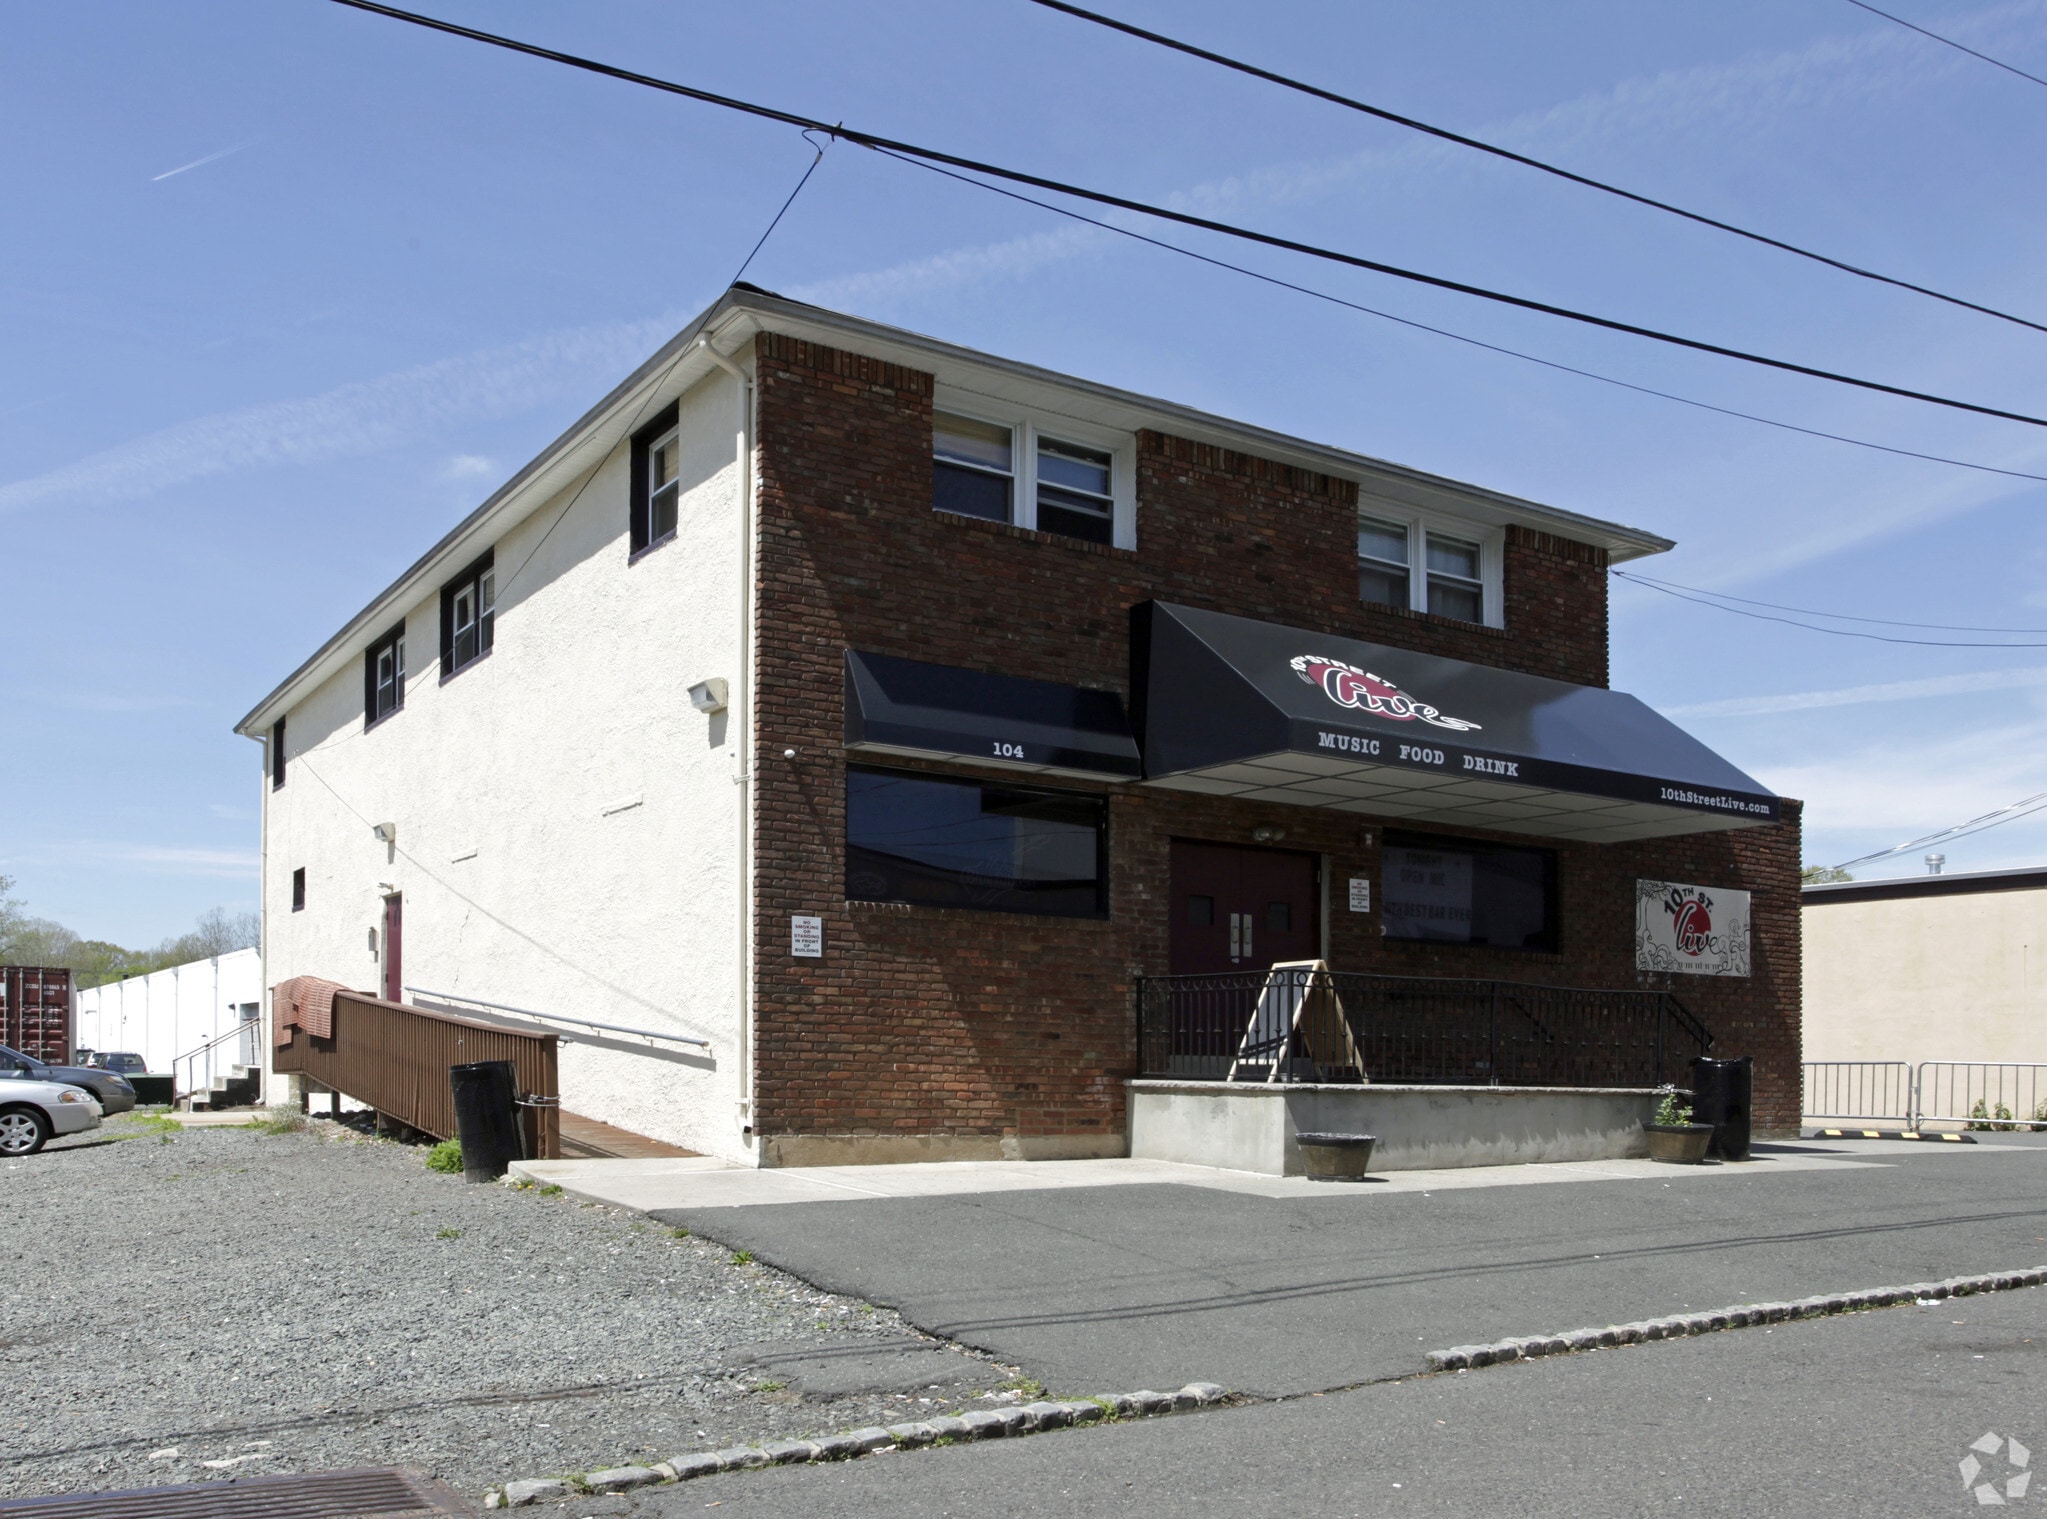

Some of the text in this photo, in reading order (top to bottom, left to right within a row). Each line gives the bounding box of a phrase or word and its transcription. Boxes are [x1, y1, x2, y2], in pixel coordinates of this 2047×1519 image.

[1304, 655, 1397, 689] STREET
[993, 742, 1024, 758] 104
[1318, 732, 1519, 777] MUSIC FOOD DRINK
[1661, 787, 1770, 814] 10thStreetLive.com
[1405, 852, 1442, 866] TONIGHT
[1400, 869, 1424, 884] OPEN
[1404, 903, 1427, 918] BEST
[1428, 905, 1446, 920] BAR
[1448, 906, 1472, 921] EVER
[1697, 892, 1714, 913] ST.
